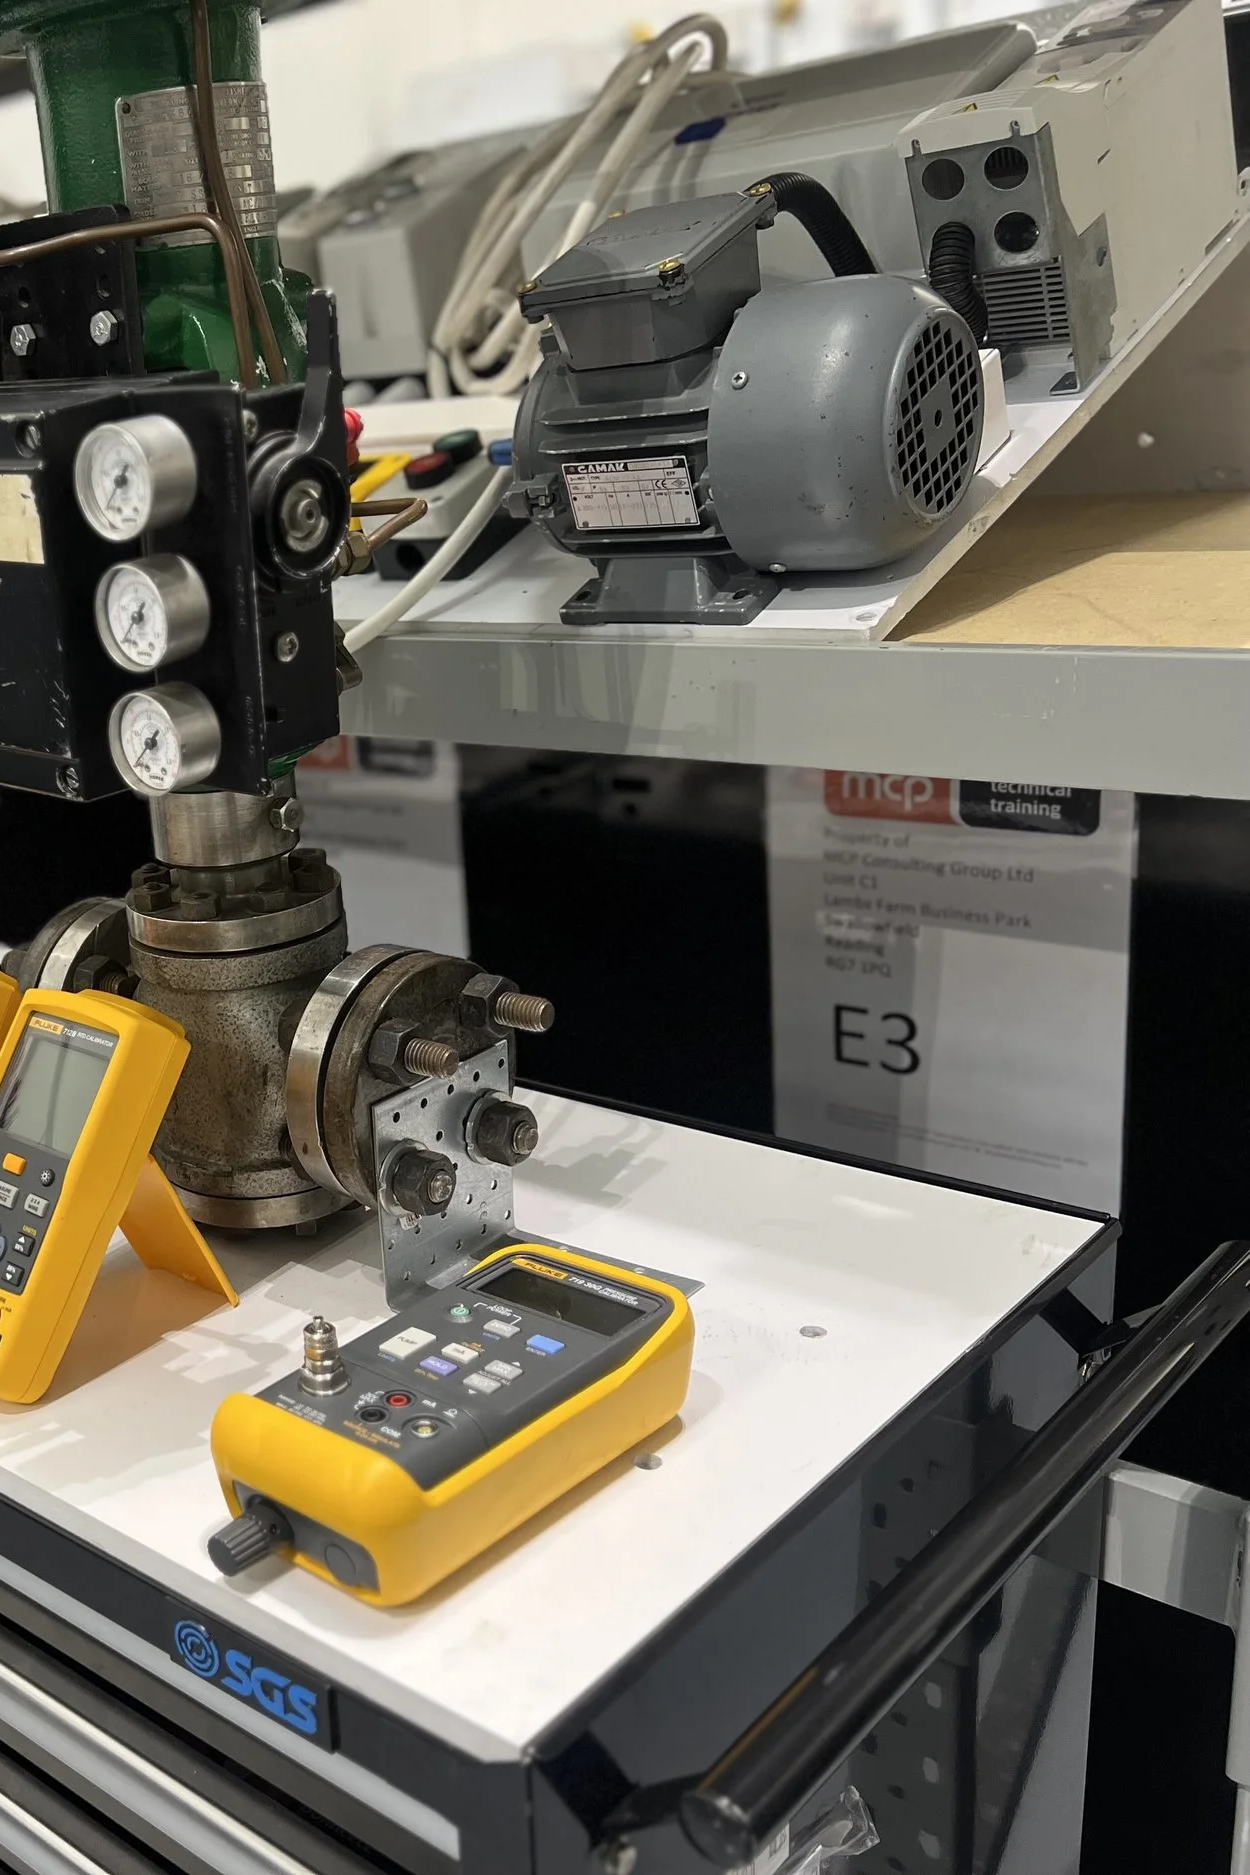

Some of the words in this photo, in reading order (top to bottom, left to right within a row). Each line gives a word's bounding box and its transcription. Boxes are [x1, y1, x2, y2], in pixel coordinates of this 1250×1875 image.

[842, 772, 934, 811] mcp
[990, 798, 1062, 819] training
[861, 851, 945, 877] Consulting
[950, 861, 1002, 881] Group
[1007, 866, 1035, 883] Ltd
[876, 897, 916, 915] Farm
[920, 903, 989, 925] Business
[994, 911, 1033, 928] Park
[34, 1019, 59, 1032] FLUKE
[62, 1027, 77, 1038] 712B
[85, 1034, 114, 1048] CALIBRATOR
[834, 1004, 920, 1075] E3
[22, 1224, 38, 1236] UNITS
[524, 1262, 564, 1278] FLUKE
[569, 1276, 585, 1285] 719
[427, 1359, 448, 1369] HOLD
[422, 1399, 437, 1408] mA
[380, 1426, 402, 1438] COM
[221, 1649, 317, 1735] SGS
